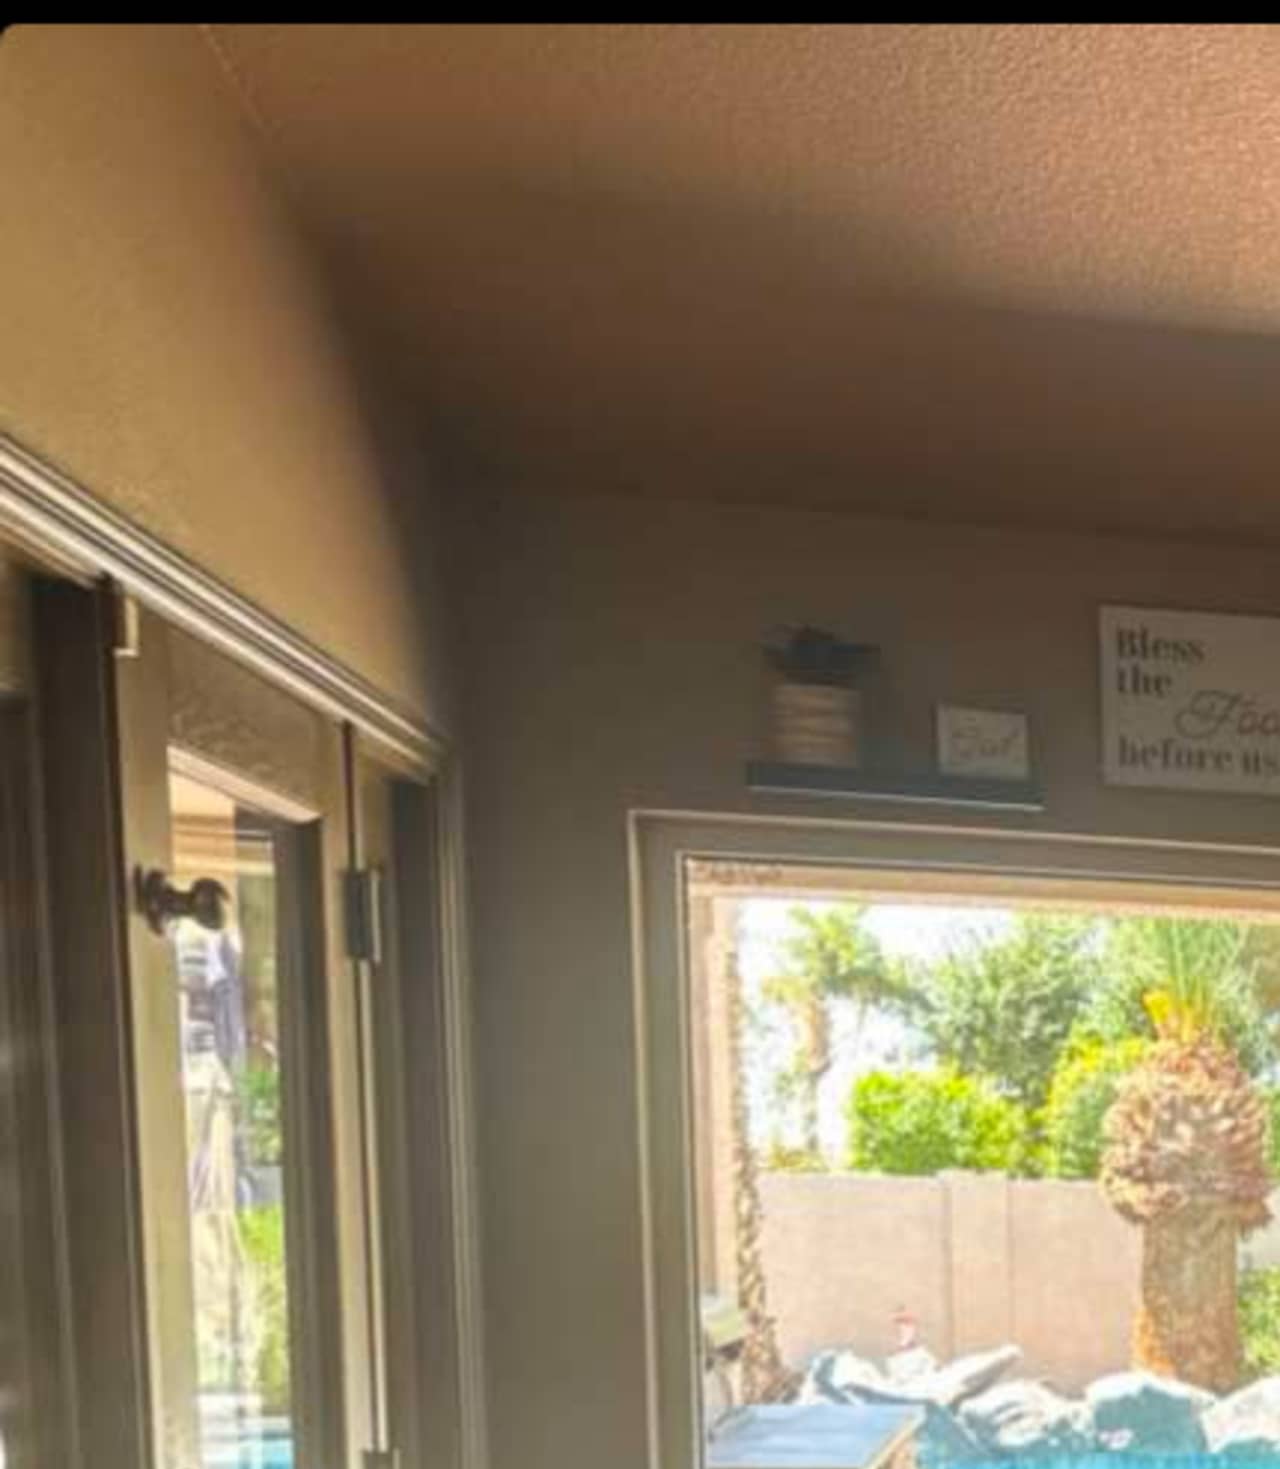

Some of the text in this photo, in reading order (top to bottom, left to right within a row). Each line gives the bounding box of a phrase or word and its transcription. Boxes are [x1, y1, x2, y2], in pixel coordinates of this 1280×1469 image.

[1115, 625, 1208, 665] Bless
[1116, 664, 1173, 698] the
[1118, 733, 1234, 772] before
